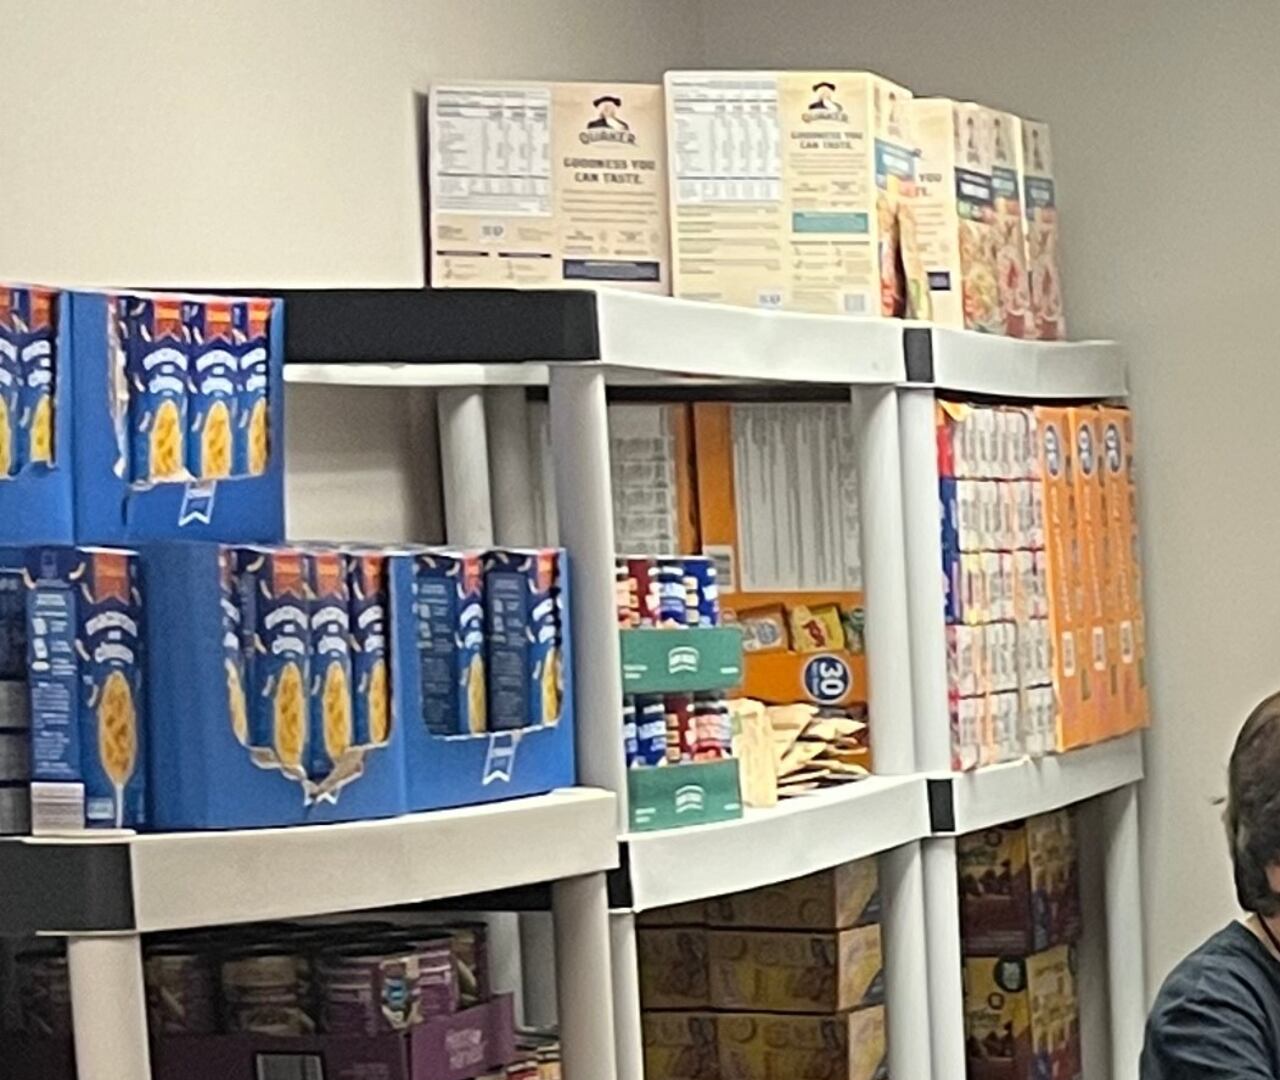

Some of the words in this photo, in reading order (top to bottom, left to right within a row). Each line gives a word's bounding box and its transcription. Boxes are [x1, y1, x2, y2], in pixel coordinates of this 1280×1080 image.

[578, 131, 637, 146] QUAKER
[631, 160, 656, 171] YOU
[574, 172, 599, 182] CAN
[819, 661, 846, 696] 30
